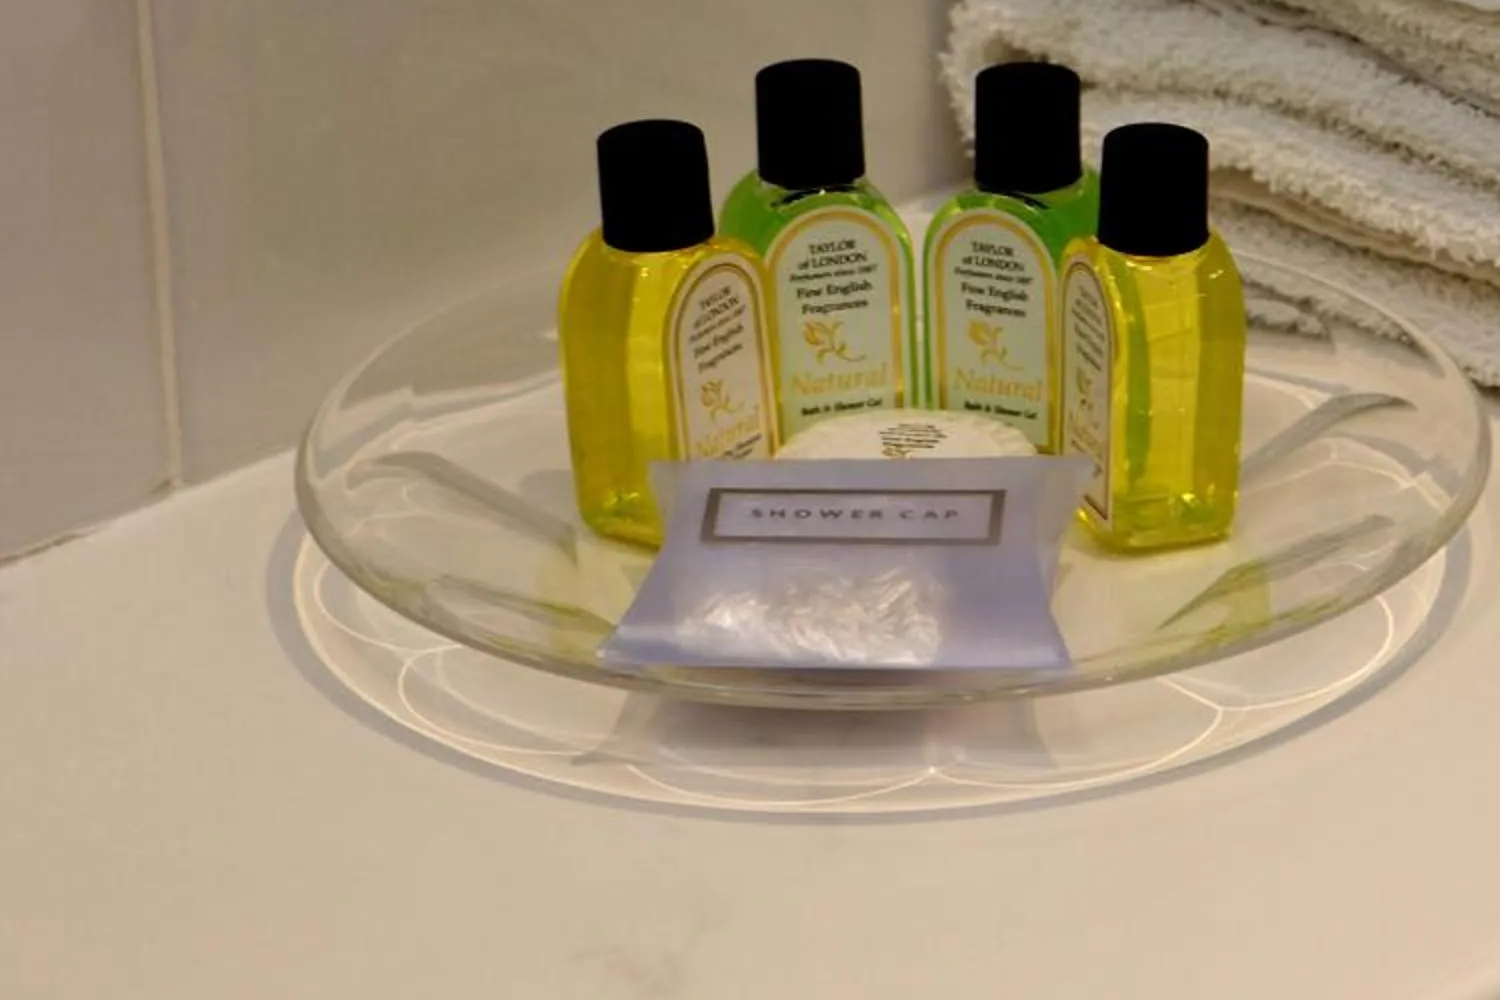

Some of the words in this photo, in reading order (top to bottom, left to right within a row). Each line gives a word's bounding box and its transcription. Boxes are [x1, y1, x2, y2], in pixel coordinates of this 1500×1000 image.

[809, 239, 856, 255] TAYLOR
[812, 252, 868, 269] LONDON
[826, 279, 874, 297] English
[987, 283, 1030, 302] English
[793, 362, 888, 396] Natural
[955, 367, 1043, 404] Natural
[751, 507, 884, 520] SHOWER
[898, 508, 960, 520] CAP
